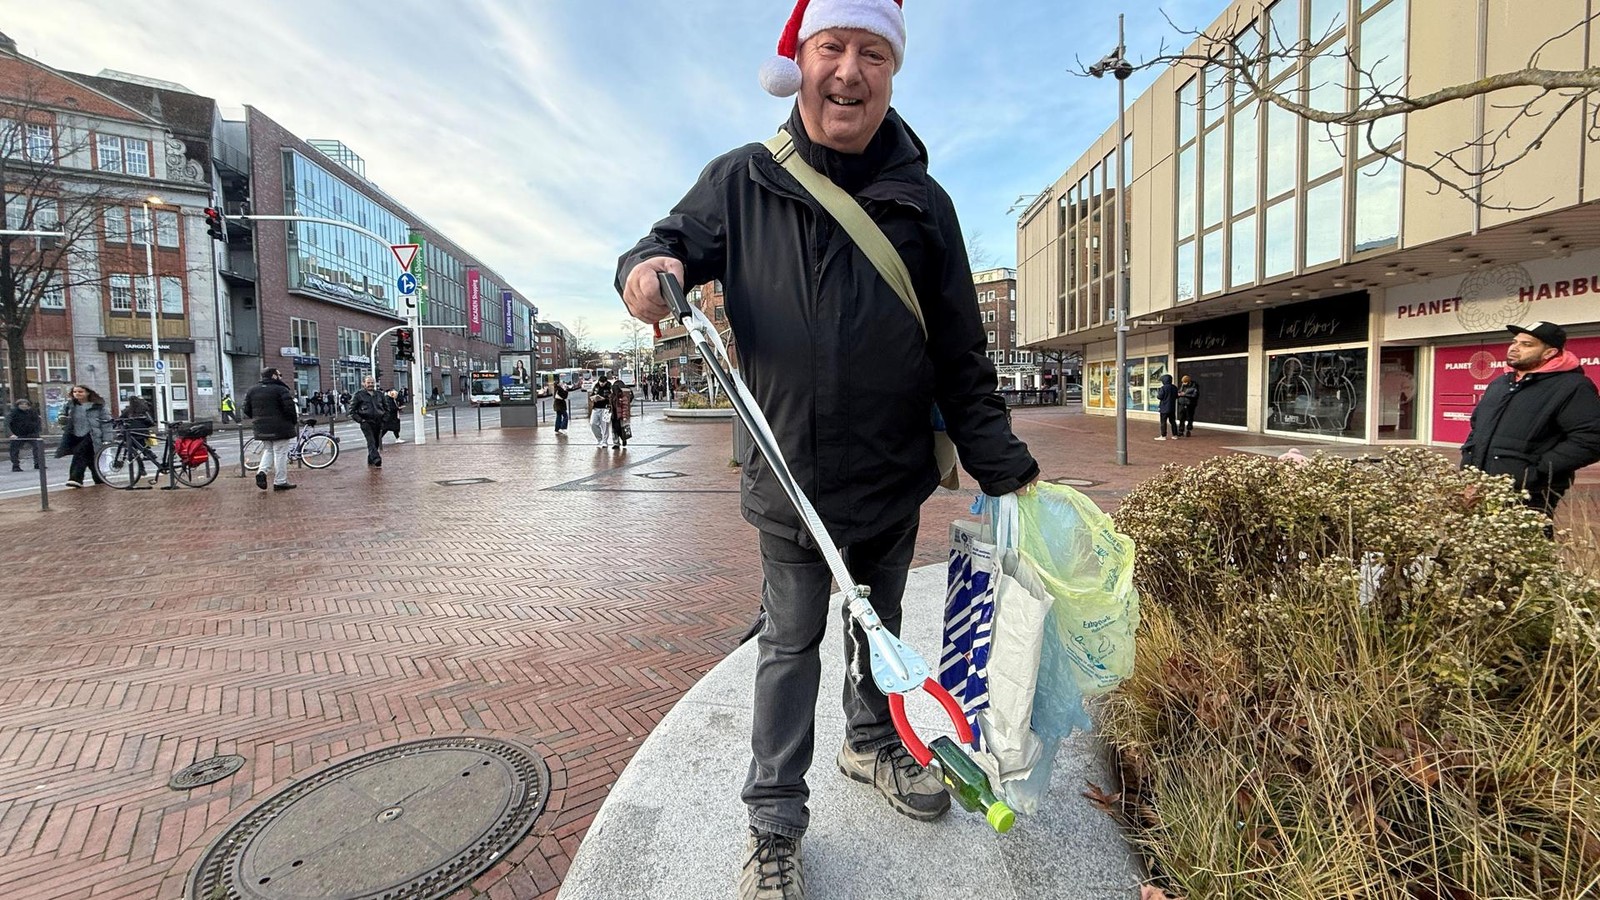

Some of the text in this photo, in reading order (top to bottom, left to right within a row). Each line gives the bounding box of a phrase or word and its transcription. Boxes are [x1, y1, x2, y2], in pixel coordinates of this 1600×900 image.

[1398, 275, 1600, 319] PLANET HARBU
[1445, 361, 1508, 370] PLANET HAR
[1580, 357, 1600, 366] PLA
